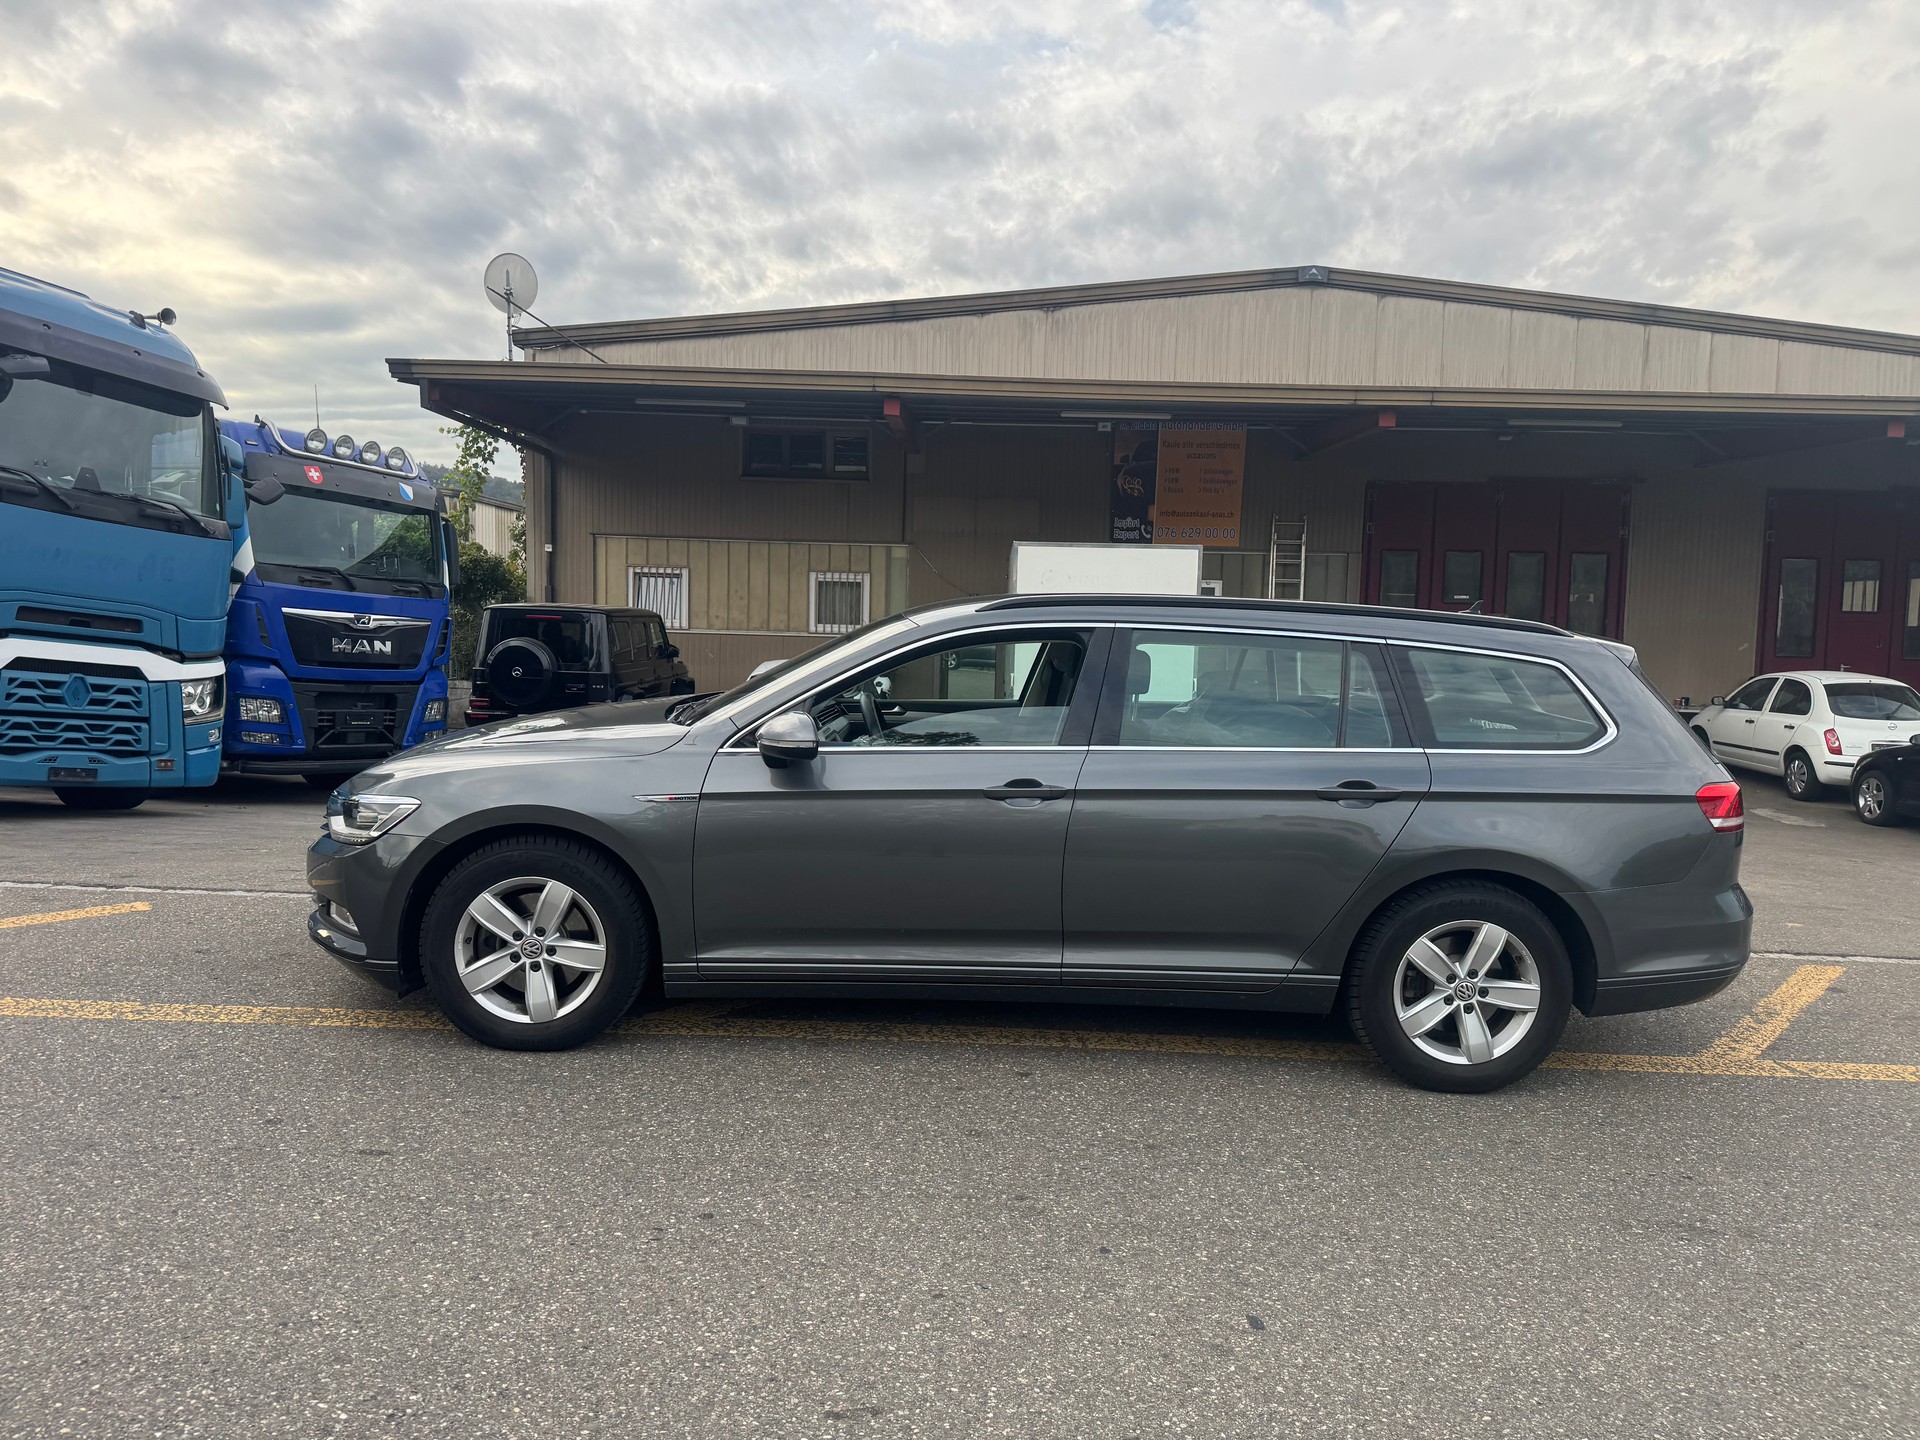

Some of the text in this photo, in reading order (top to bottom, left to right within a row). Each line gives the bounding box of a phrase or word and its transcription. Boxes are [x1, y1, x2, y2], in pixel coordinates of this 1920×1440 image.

[1162, 440, 1240, 450] Kaufe alle verschiedenen
[1186, 452, 1217, 460] occasions
[1113, 517, 1140, 529] Import
[1113, 528, 1140, 541] Export
[1157, 526, 1236, 540] 076 629 00 00
[331, 637, 393, 656] MAN
